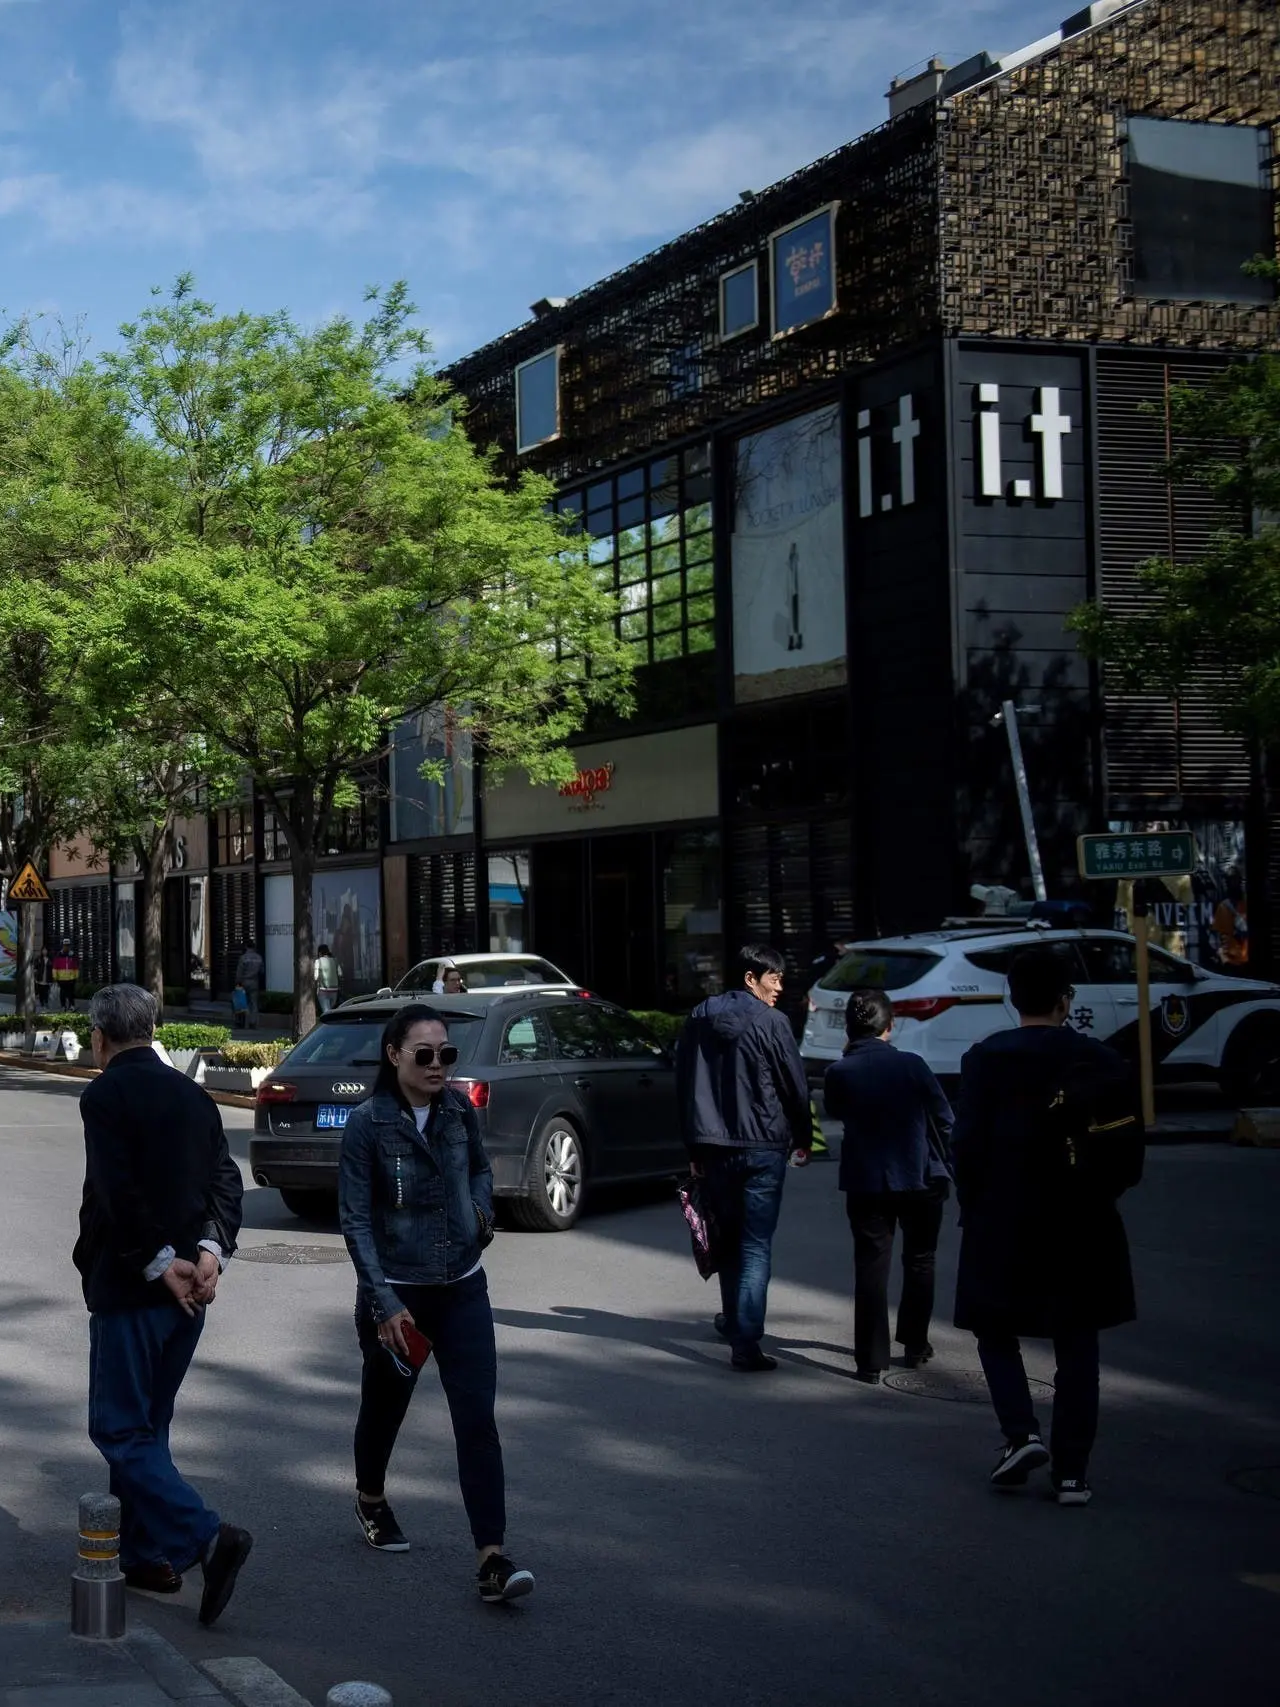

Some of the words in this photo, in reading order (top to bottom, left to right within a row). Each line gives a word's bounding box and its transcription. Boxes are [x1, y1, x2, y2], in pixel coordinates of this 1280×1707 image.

[858, 394, 920, 518] i.t
[979, 383, 1071, 499] i.t
[1095, 840, 1162, 859] 雅秀东路
